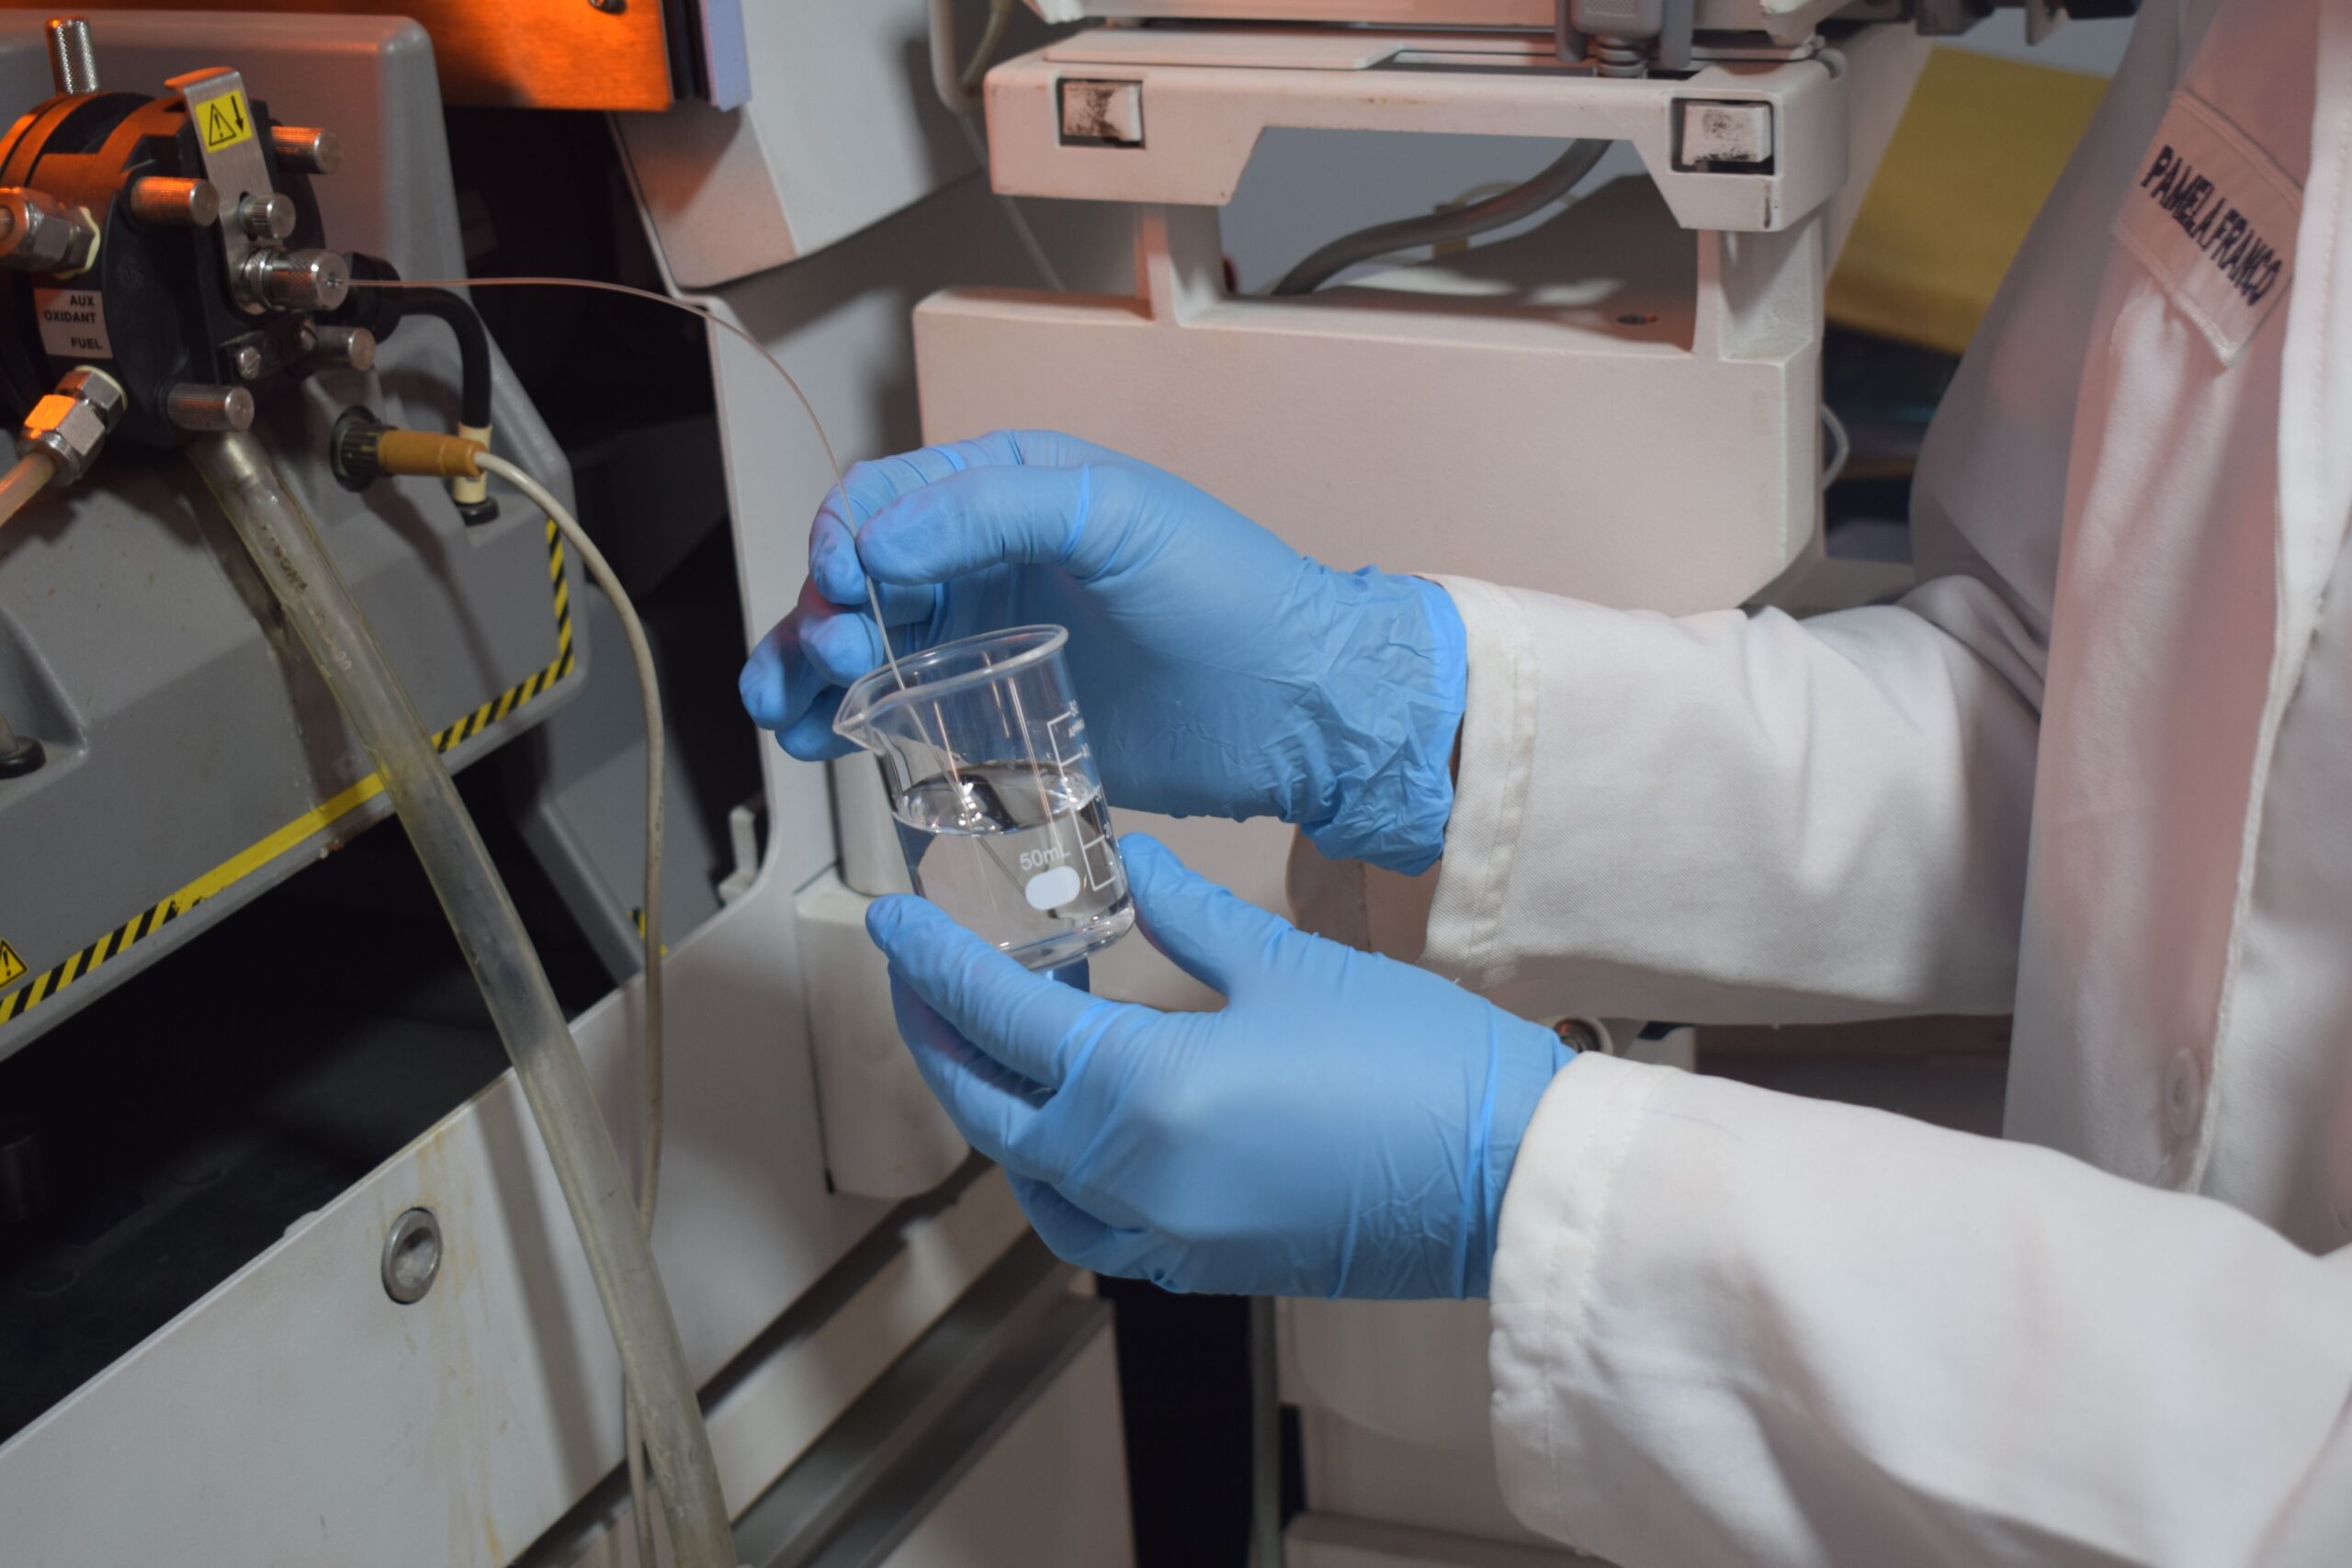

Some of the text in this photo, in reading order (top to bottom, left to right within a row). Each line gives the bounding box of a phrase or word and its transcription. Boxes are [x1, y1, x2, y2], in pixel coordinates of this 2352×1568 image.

[2140, 144, 2282, 306] PAMELA FRANCO
[70, 295, 95, 307] AUX
[43, 310, 96, 323] OXIDANT
[71, 336, 103, 349] FUEL
[1020, 841, 1071, 871] 50mL
